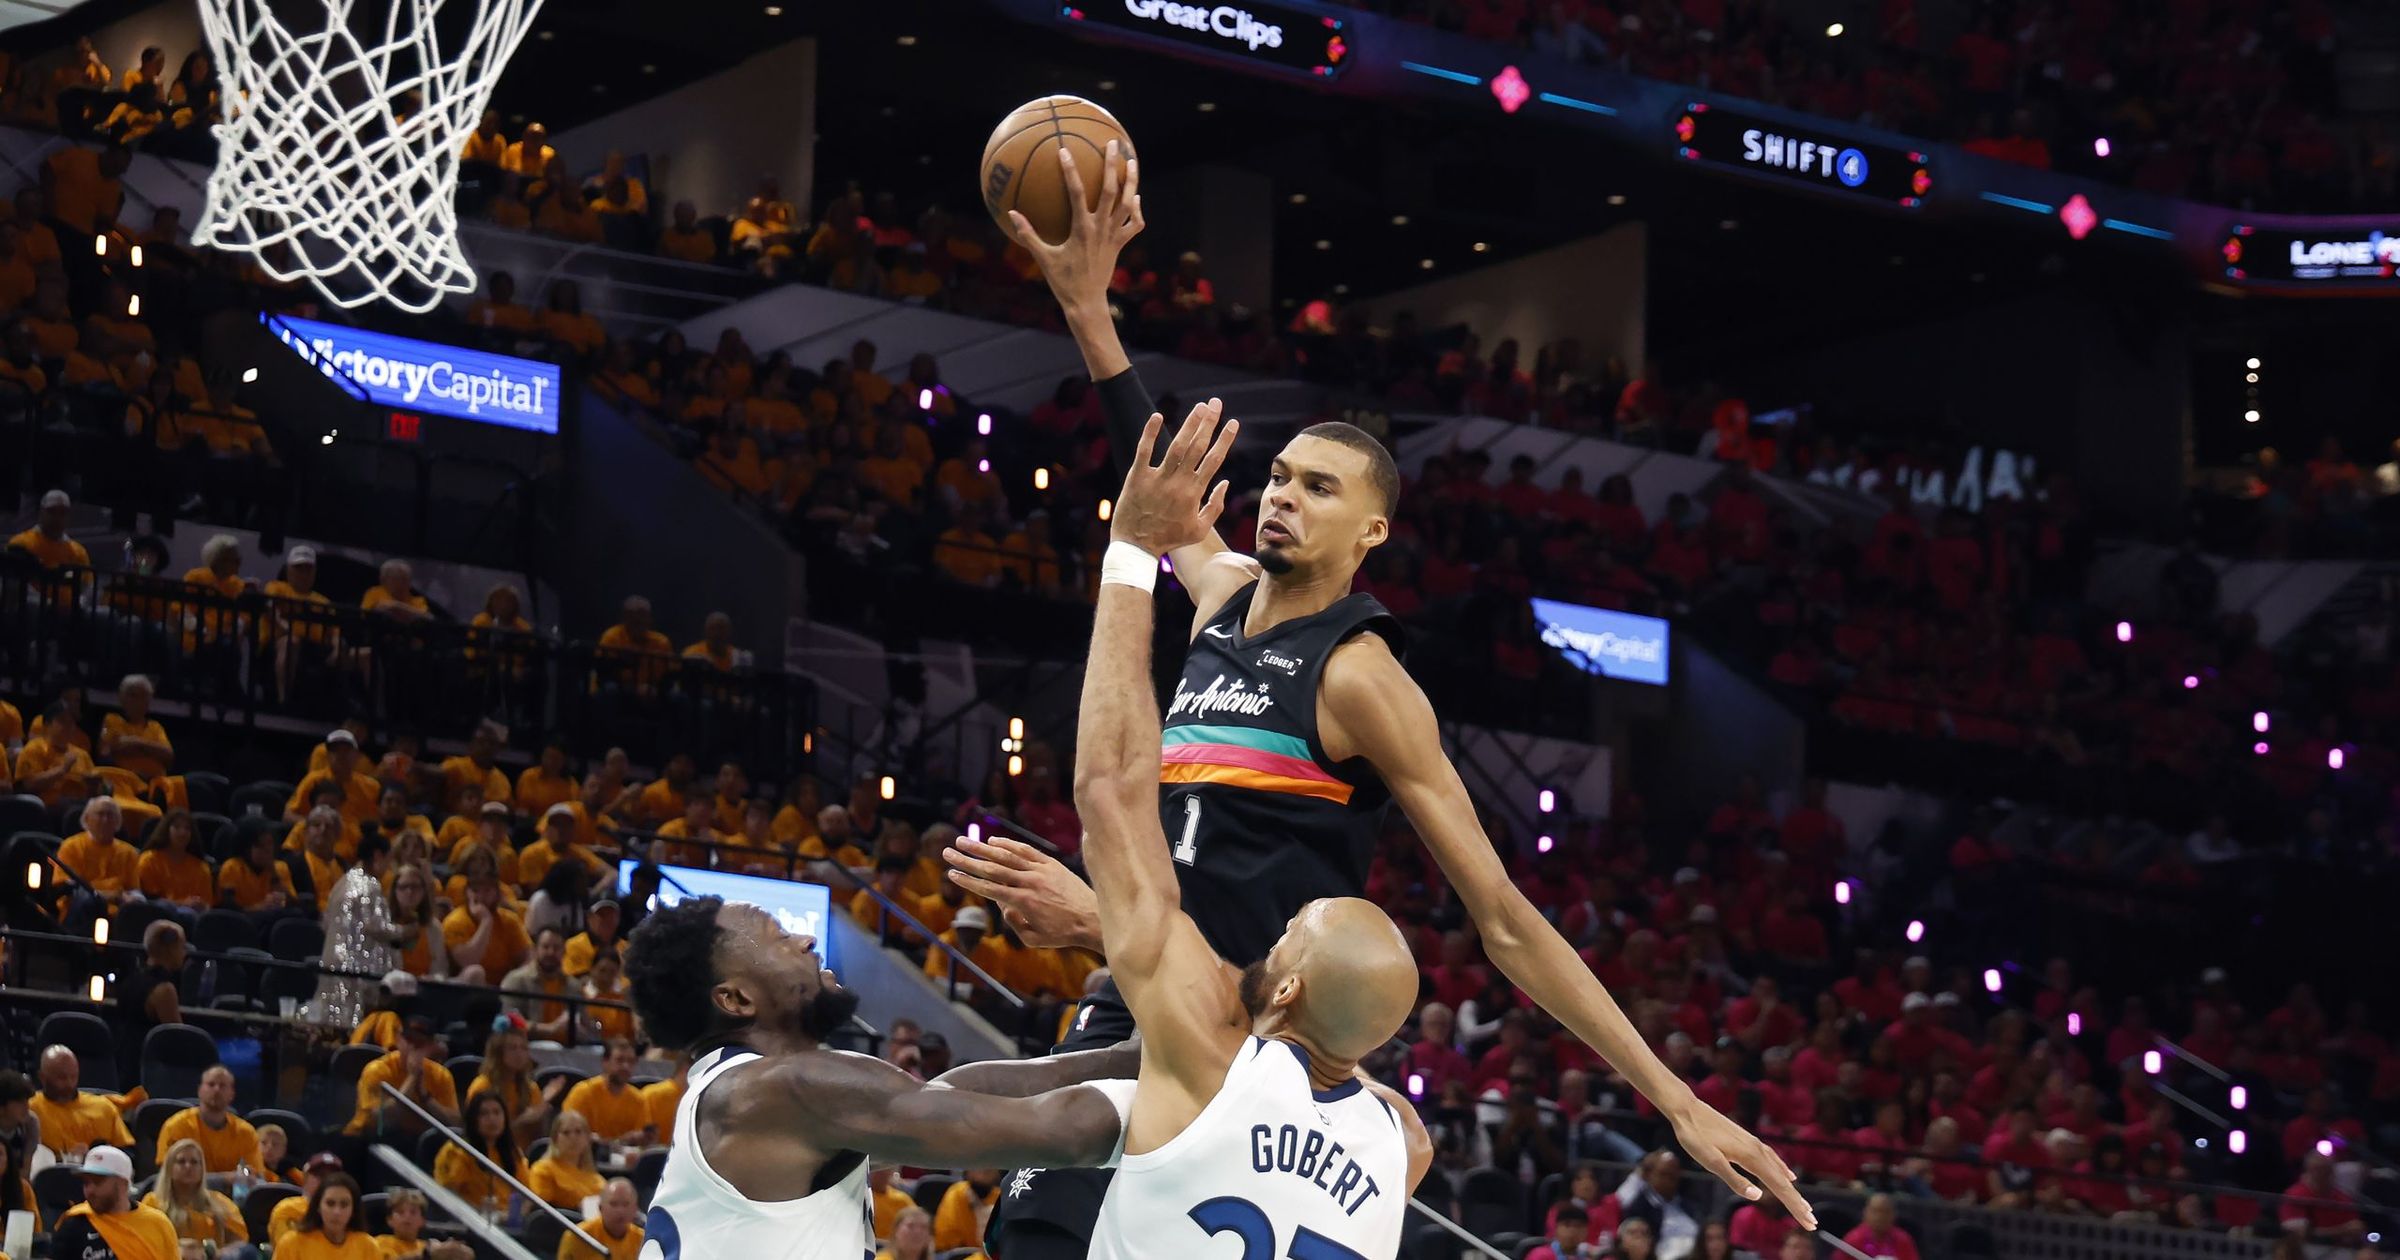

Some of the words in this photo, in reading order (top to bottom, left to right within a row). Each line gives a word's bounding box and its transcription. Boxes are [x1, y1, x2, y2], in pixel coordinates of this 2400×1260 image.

[1210, 6, 1283, 50] Clips
[1263, 654, 1295, 670] LEDGER
[1188, 674, 1274, 719] Antonio
[1172, 794, 1202, 867] 1
[1251, 1123, 1381, 1218] GOBERT
